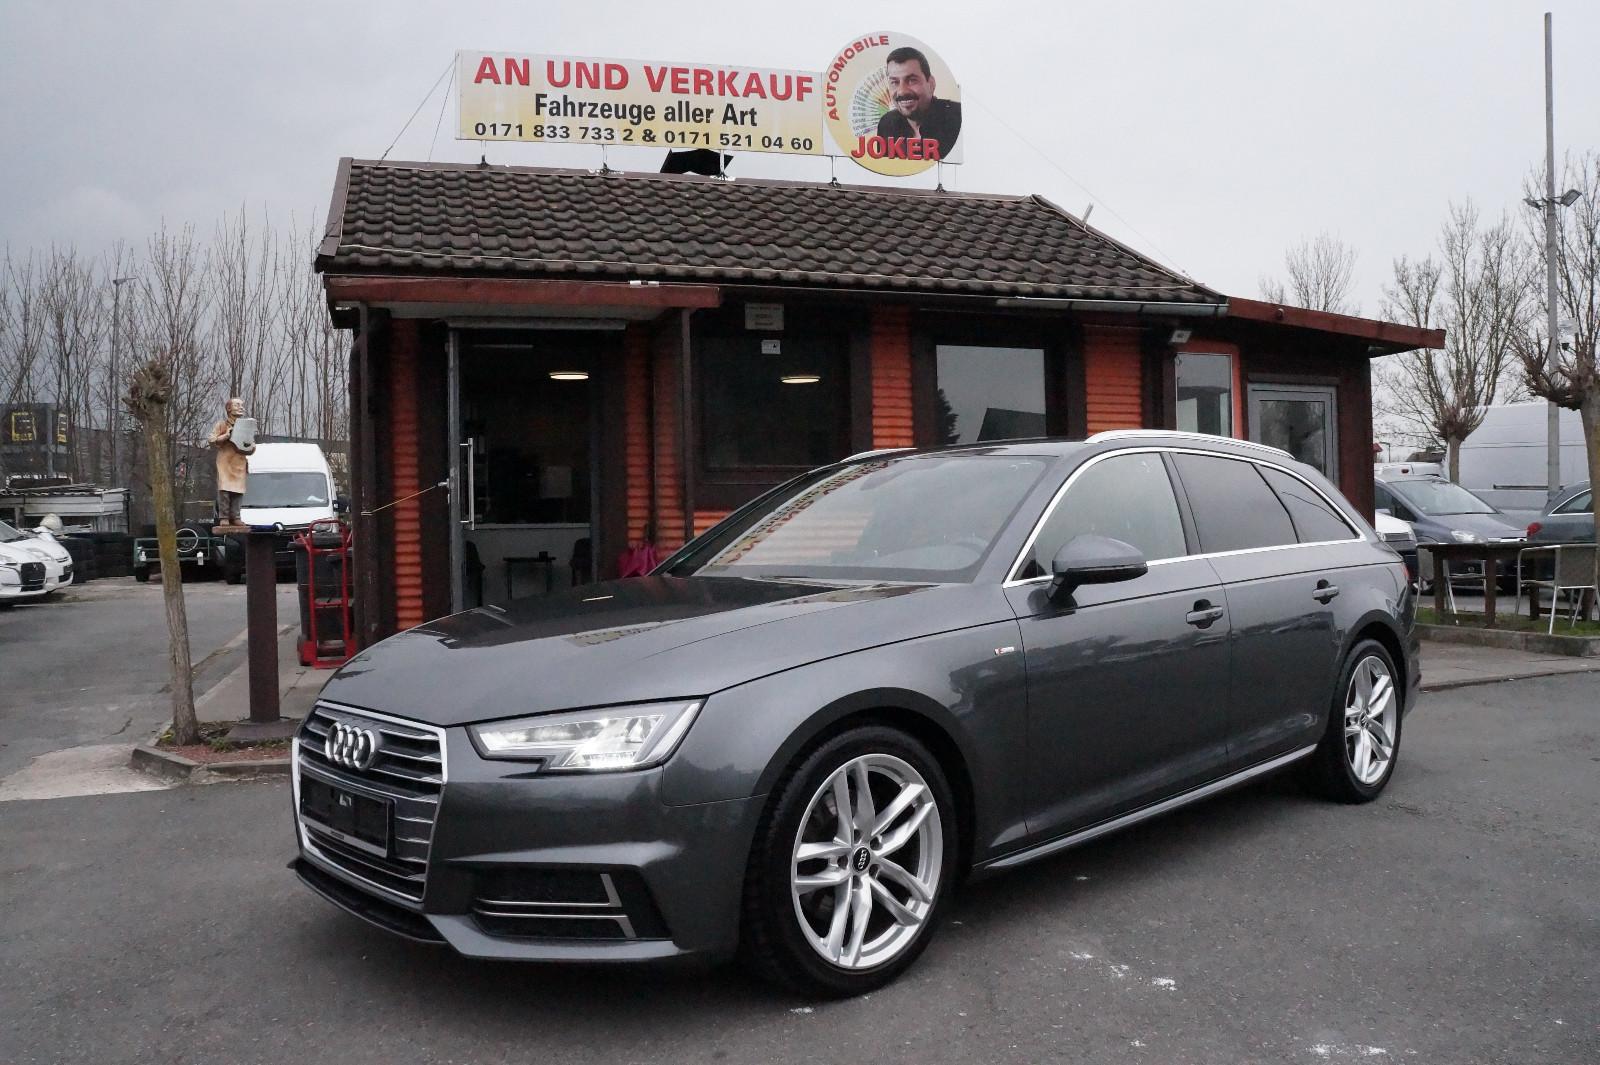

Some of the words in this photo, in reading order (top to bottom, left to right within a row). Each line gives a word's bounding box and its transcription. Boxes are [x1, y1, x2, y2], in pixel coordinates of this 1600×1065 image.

[474, 56, 530, 86] AN
[546, 60, 629, 91] UND
[643, 65, 813, 102] VERKAUF
[826, 35, 889, 121] AUTOMOBILE
[535, 93, 656, 126] Fahrzeuge
[664, 100, 714, 124] aller
[721, 103, 757, 127] Art
[474, 122, 524, 137] 0171
[533, 124, 570, 139] 833
[578, 126, 615, 141] 733
[622, 128, 634, 142] 2
[641, 128, 656, 143] &
[664, 130, 711, 145] 0171
[719, 132, 752, 147] 521
[761, 135, 784, 149] 04
[790, 137, 813, 151] 60
[850, 135, 941, 161] JOKER
